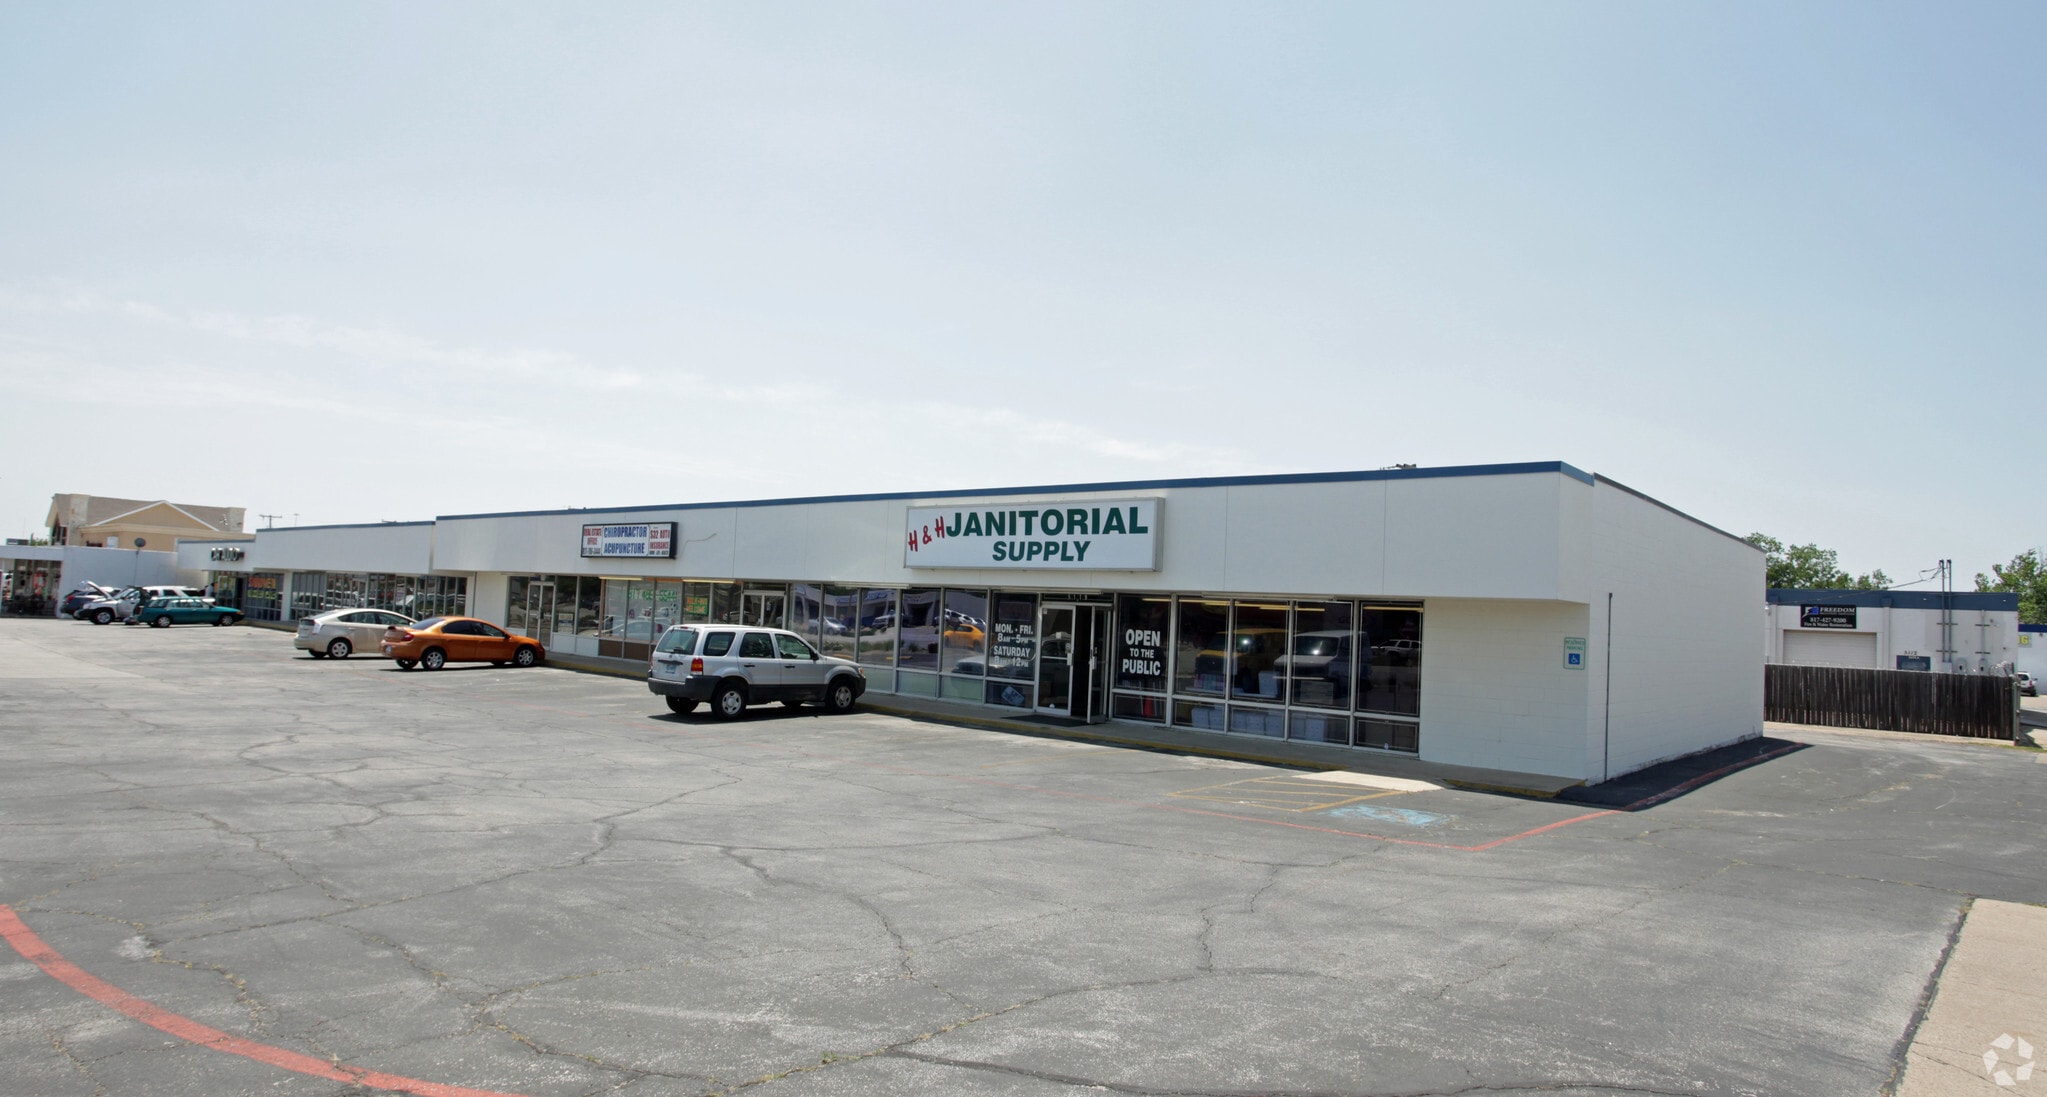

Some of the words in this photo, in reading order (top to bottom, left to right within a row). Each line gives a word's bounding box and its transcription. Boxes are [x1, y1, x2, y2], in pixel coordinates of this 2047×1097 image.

[946, 507, 1148, 537] JANITORIAL
[603, 526, 648, 538] CHIROPRACTOR
[908, 530, 918, 552] H
[922, 525, 932, 545] &
[935, 516, 945, 539] H
[603, 542, 645, 554] ACUPUNCTURE
[992, 541, 1091, 562] SUPPLY
[995, 623, 1013, 633] MON.
[1020, 625, 1033, 635] FRI.
[1125, 628, 1161, 647] OPEN
[994, 645, 1030, 657] SATURDAY
[1130, 648, 1139, 657] TO
[1141, 649, 1154, 659] THE
[1122, 659, 1161, 676] PUBLIC
